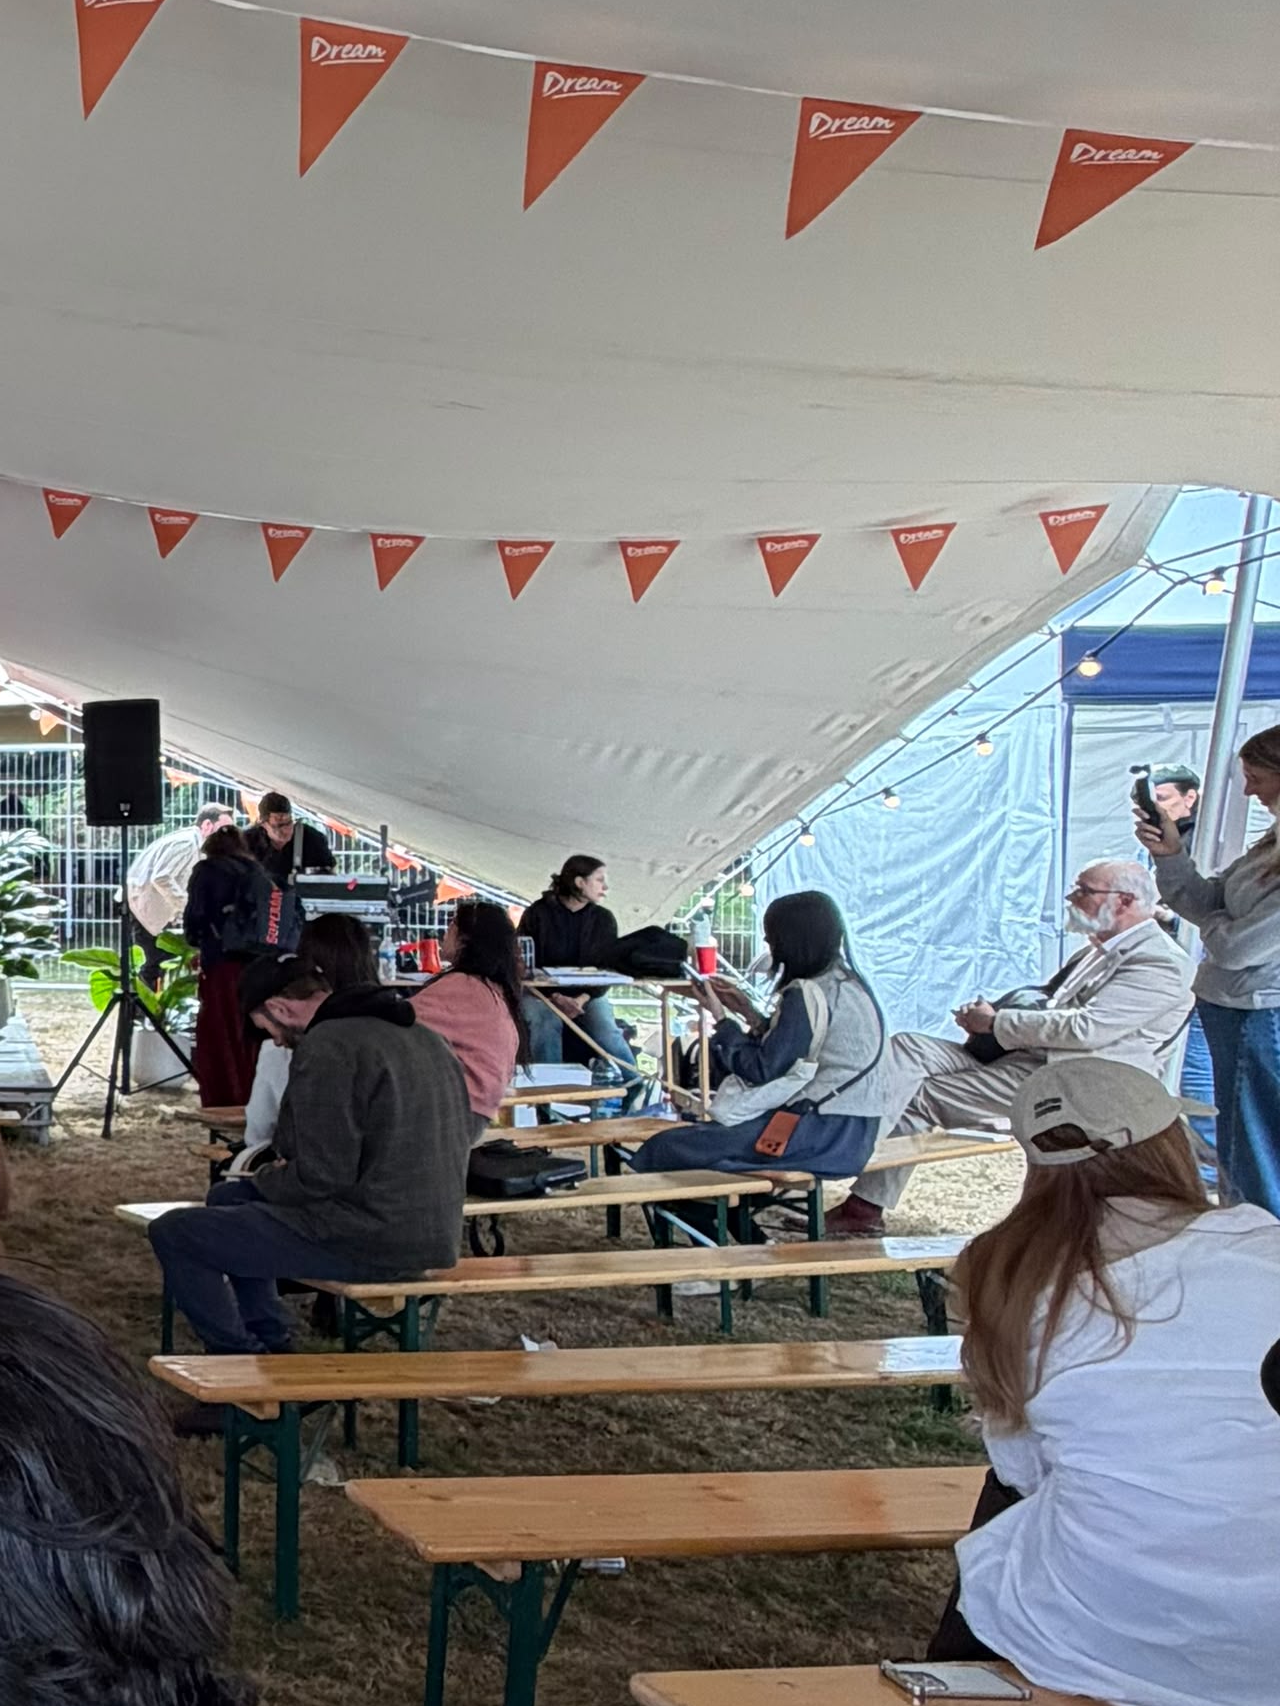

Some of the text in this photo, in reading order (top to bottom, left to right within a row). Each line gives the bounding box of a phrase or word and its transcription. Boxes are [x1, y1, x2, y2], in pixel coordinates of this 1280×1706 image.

[311, 37, 386, 65] Dream
[543, 72, 622, 98] Dream
[810, 113, 894, 139] Dream
[1070, 143, 1163, 164] Dream
